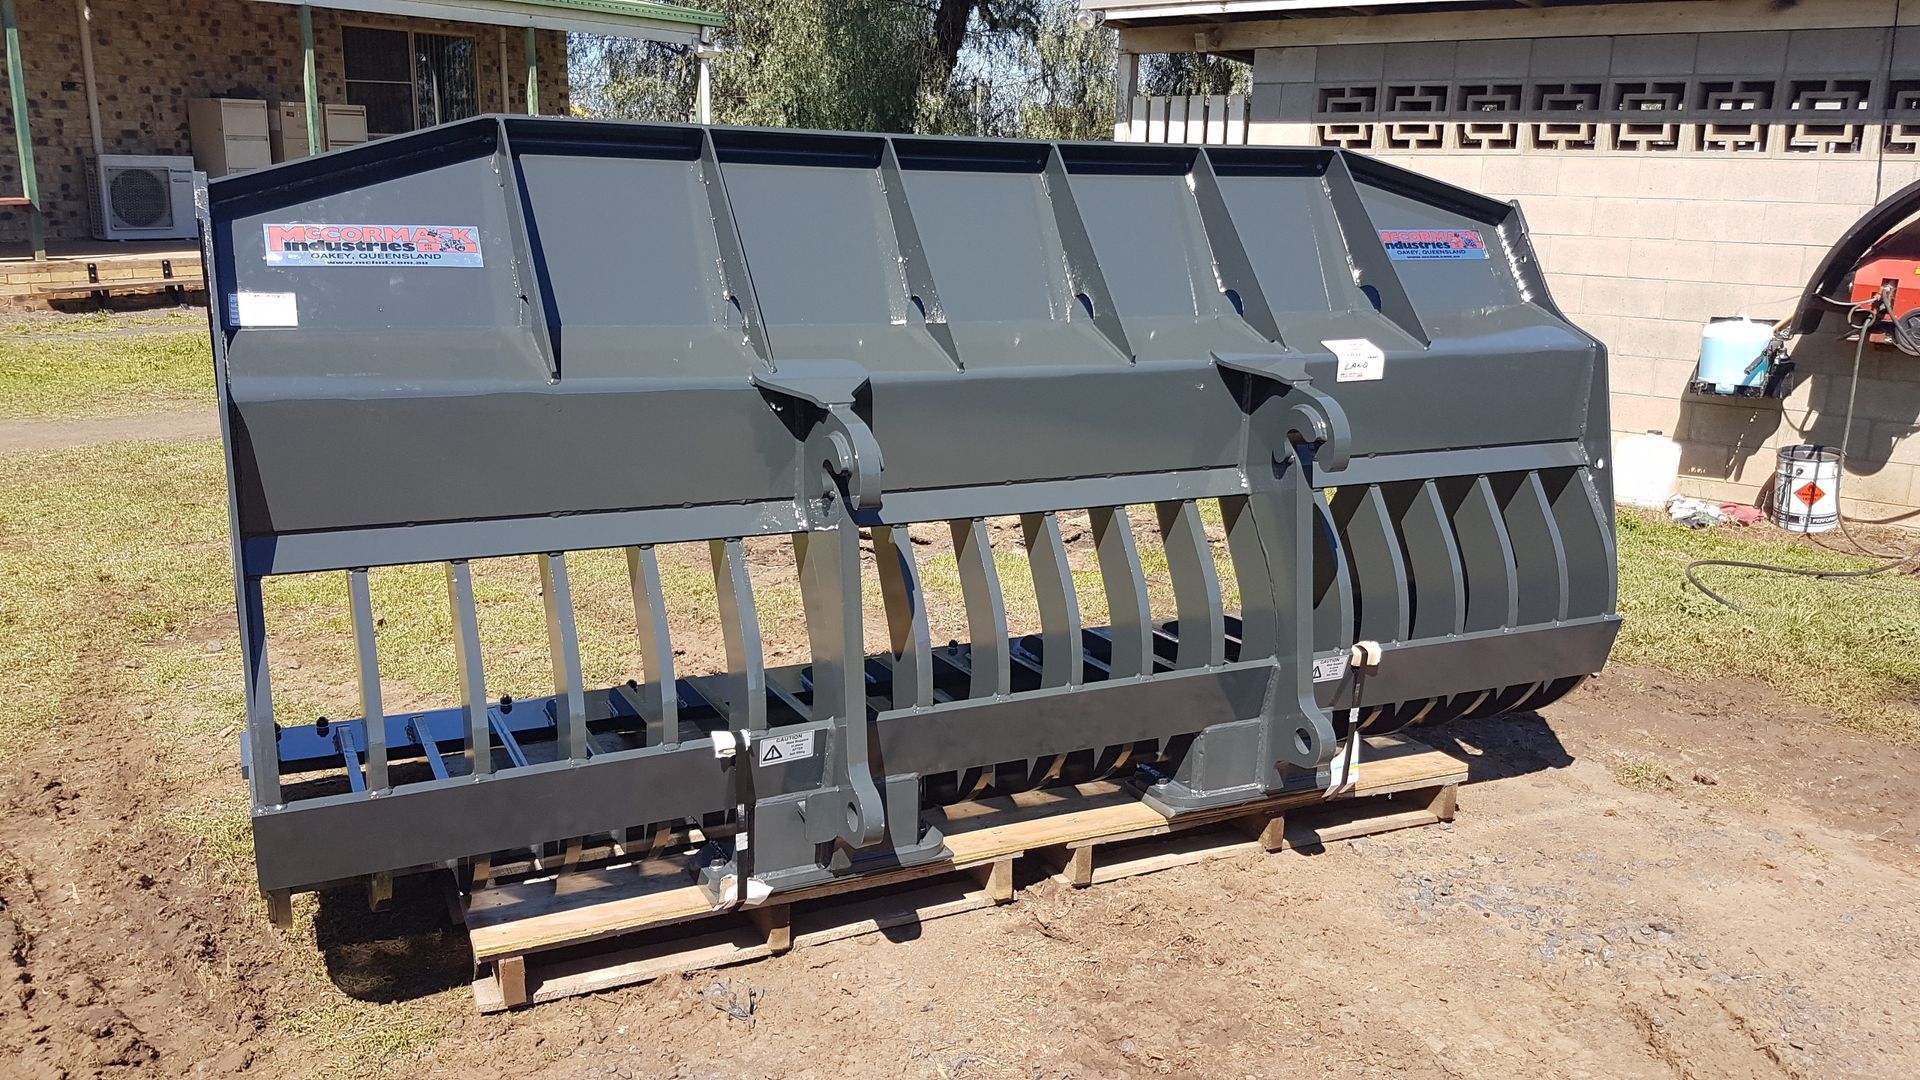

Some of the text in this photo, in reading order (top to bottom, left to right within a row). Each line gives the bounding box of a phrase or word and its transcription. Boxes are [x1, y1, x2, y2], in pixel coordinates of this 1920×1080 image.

[284, 240, 415, 252] industries
[1385, 241, 1451, 250] ndustries
[776, 733, 803, 743] CAUTION
